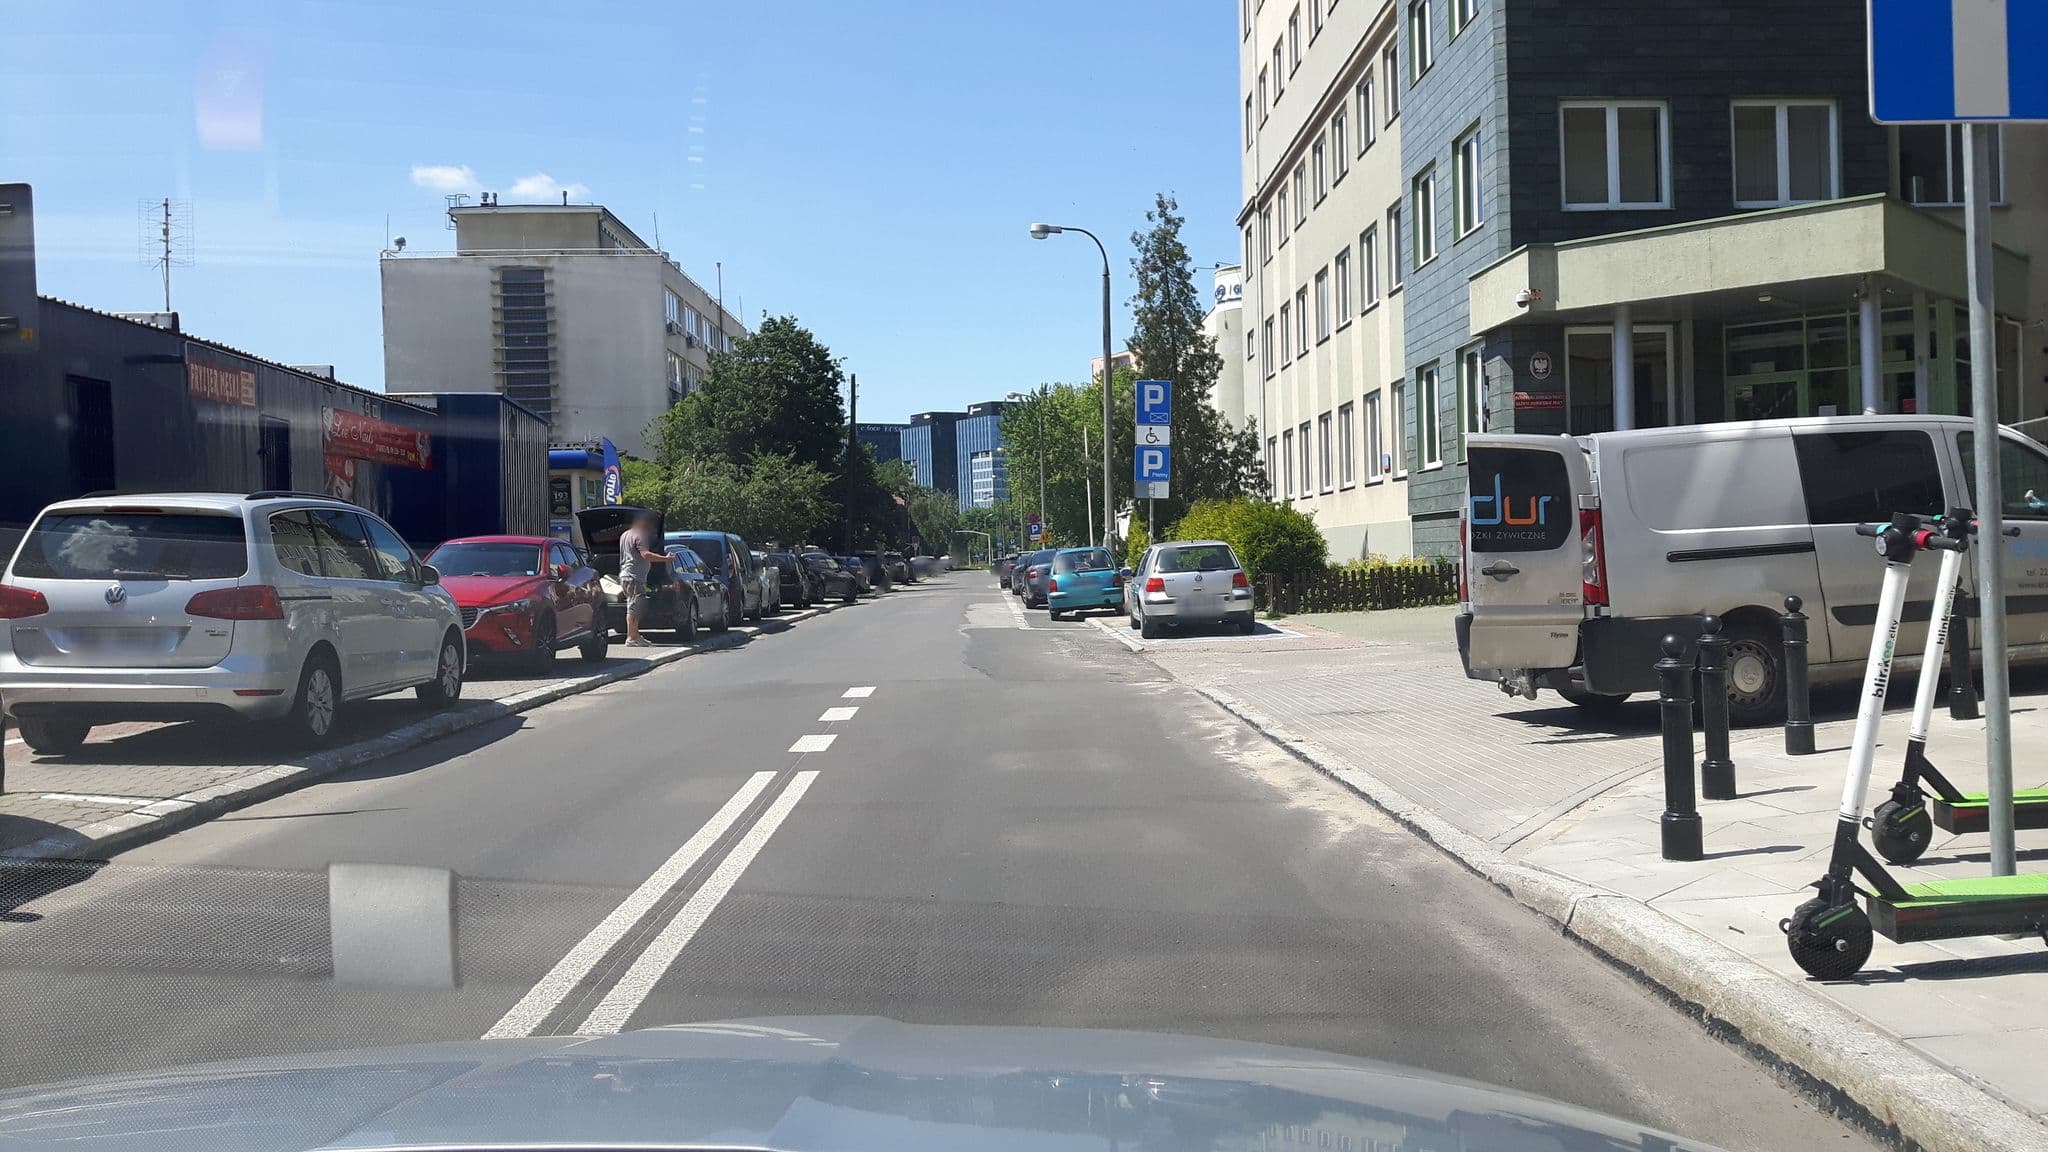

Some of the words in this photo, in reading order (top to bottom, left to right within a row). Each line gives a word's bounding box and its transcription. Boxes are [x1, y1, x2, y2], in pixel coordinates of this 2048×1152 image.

[1144, 384, 1164, 412] P
[1143, 450, 1163, 478] P
[606, 473, 616, 503] LOTTO
[1031, 524, 1039, 534] P
